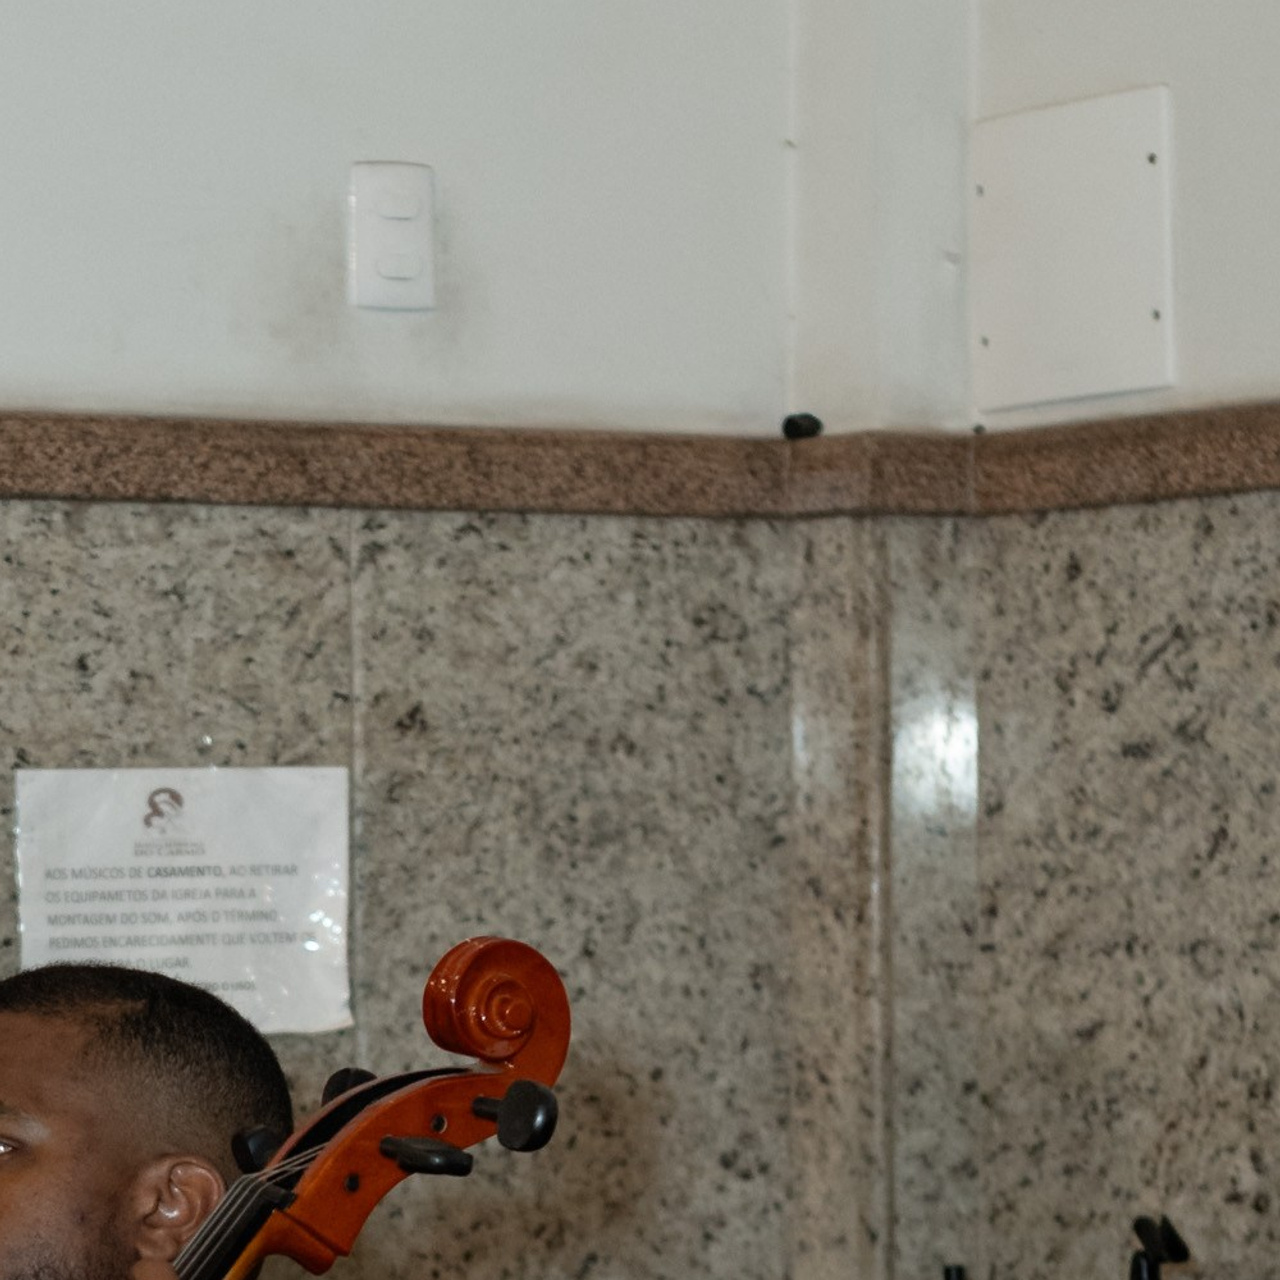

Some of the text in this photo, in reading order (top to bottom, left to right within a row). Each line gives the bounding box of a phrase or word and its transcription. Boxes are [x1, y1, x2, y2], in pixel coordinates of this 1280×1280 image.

[44, 867, 68, 881] AOS
[128, 866, 143, 879] DE
[228, 864, 247, 877] AO
[249, 863, 298, 877] RETIRAR
[45, 890, 61, 904] OS
[151, 888, 168, 902] DA
[171, 887, 211, 901] IGREJA
[214, 887, 245, 900] PARA
[248, 887, 257, 899] A
[46, 912, 118, 926] MONTAGEM
[120, 911, 138, 925] DO
[48, 935, 100, 950] PEDIMOS
[102, 932, 217, 949] ENCARECIDAMENTE
[221, 931, 246, 946] QUE
[249, 931, 297, 945] VOLTEM
